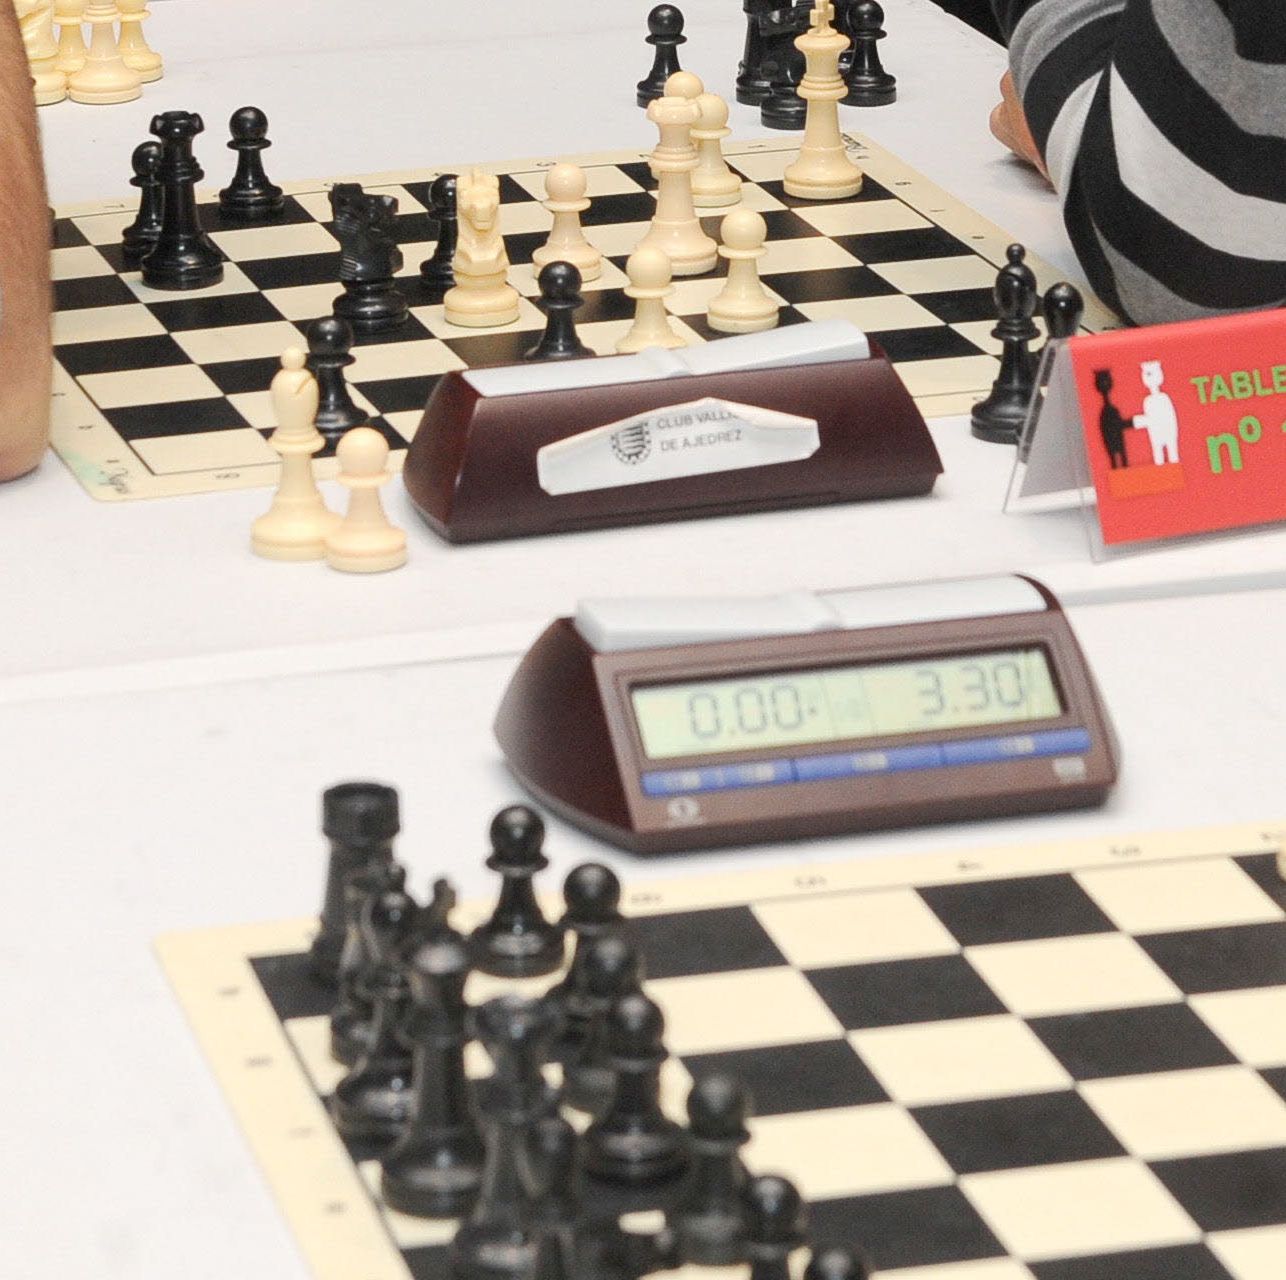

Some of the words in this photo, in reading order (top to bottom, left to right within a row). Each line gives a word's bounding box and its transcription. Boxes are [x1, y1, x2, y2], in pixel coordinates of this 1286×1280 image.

[656, 414, 694, 429] CLUB
[660, 438, 679, 452] DE
[682, 428, 742, 448] AJEDREZ
[916, 659, 1026, 718] 3.30
